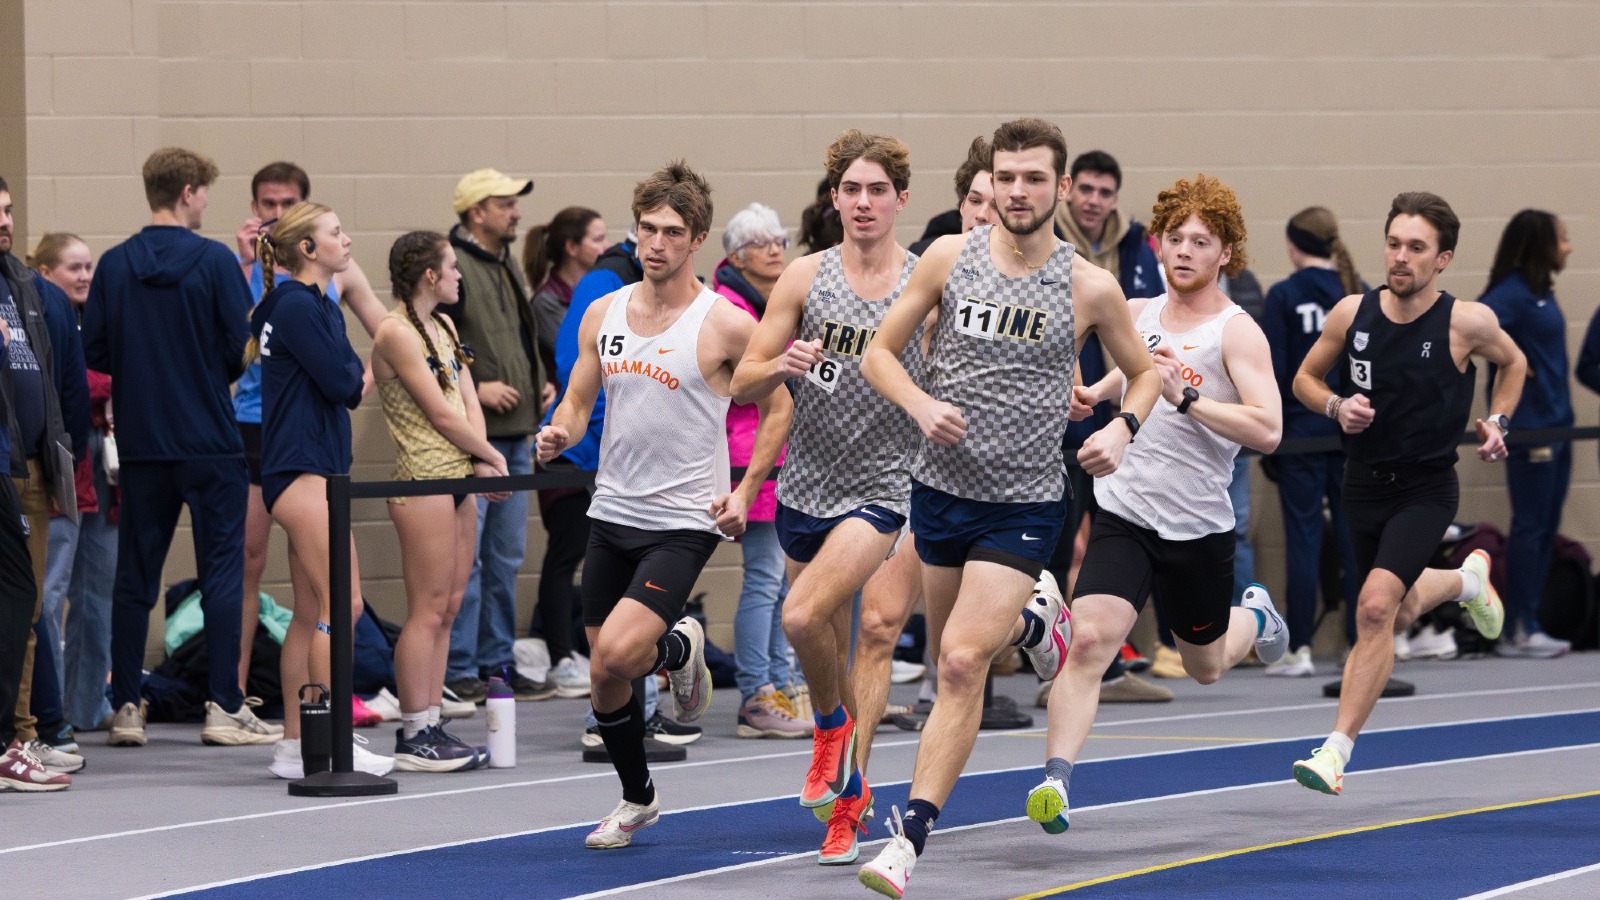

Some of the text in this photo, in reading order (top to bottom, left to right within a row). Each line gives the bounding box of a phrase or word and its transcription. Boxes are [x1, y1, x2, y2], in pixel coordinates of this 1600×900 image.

[959, 305, 992, 332] 11
[600, 334, 625, 356] 15
[822, 320, 878, 358] TRI
